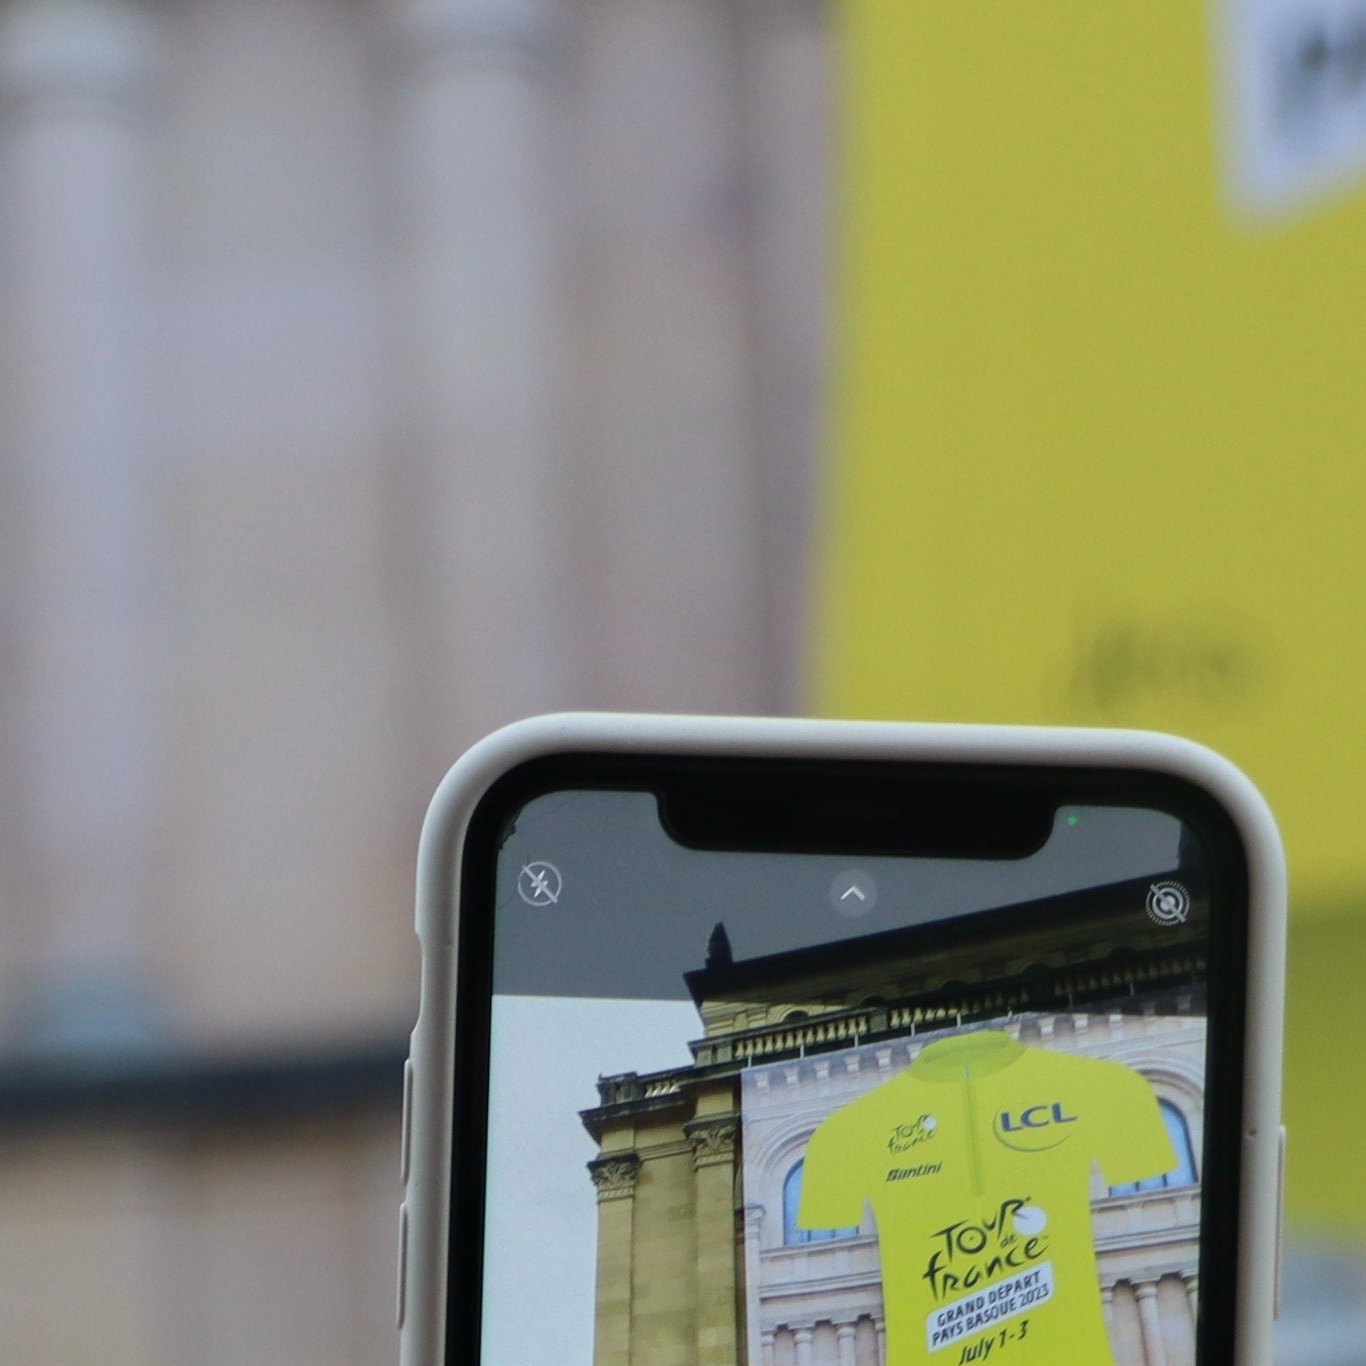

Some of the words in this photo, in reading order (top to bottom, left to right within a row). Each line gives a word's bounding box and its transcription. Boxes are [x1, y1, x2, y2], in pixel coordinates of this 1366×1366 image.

[1001, 1103, 1078, 1132] LCL
[932, 1320, 963, 1346] PAYS
[966, 1297, 1017, 1331] BASQUE
[1018, 1283, 1049, 1308] 2023
[937, 1296, 985, 1327] GRAND
[958, 1337, 996, 1366] July
